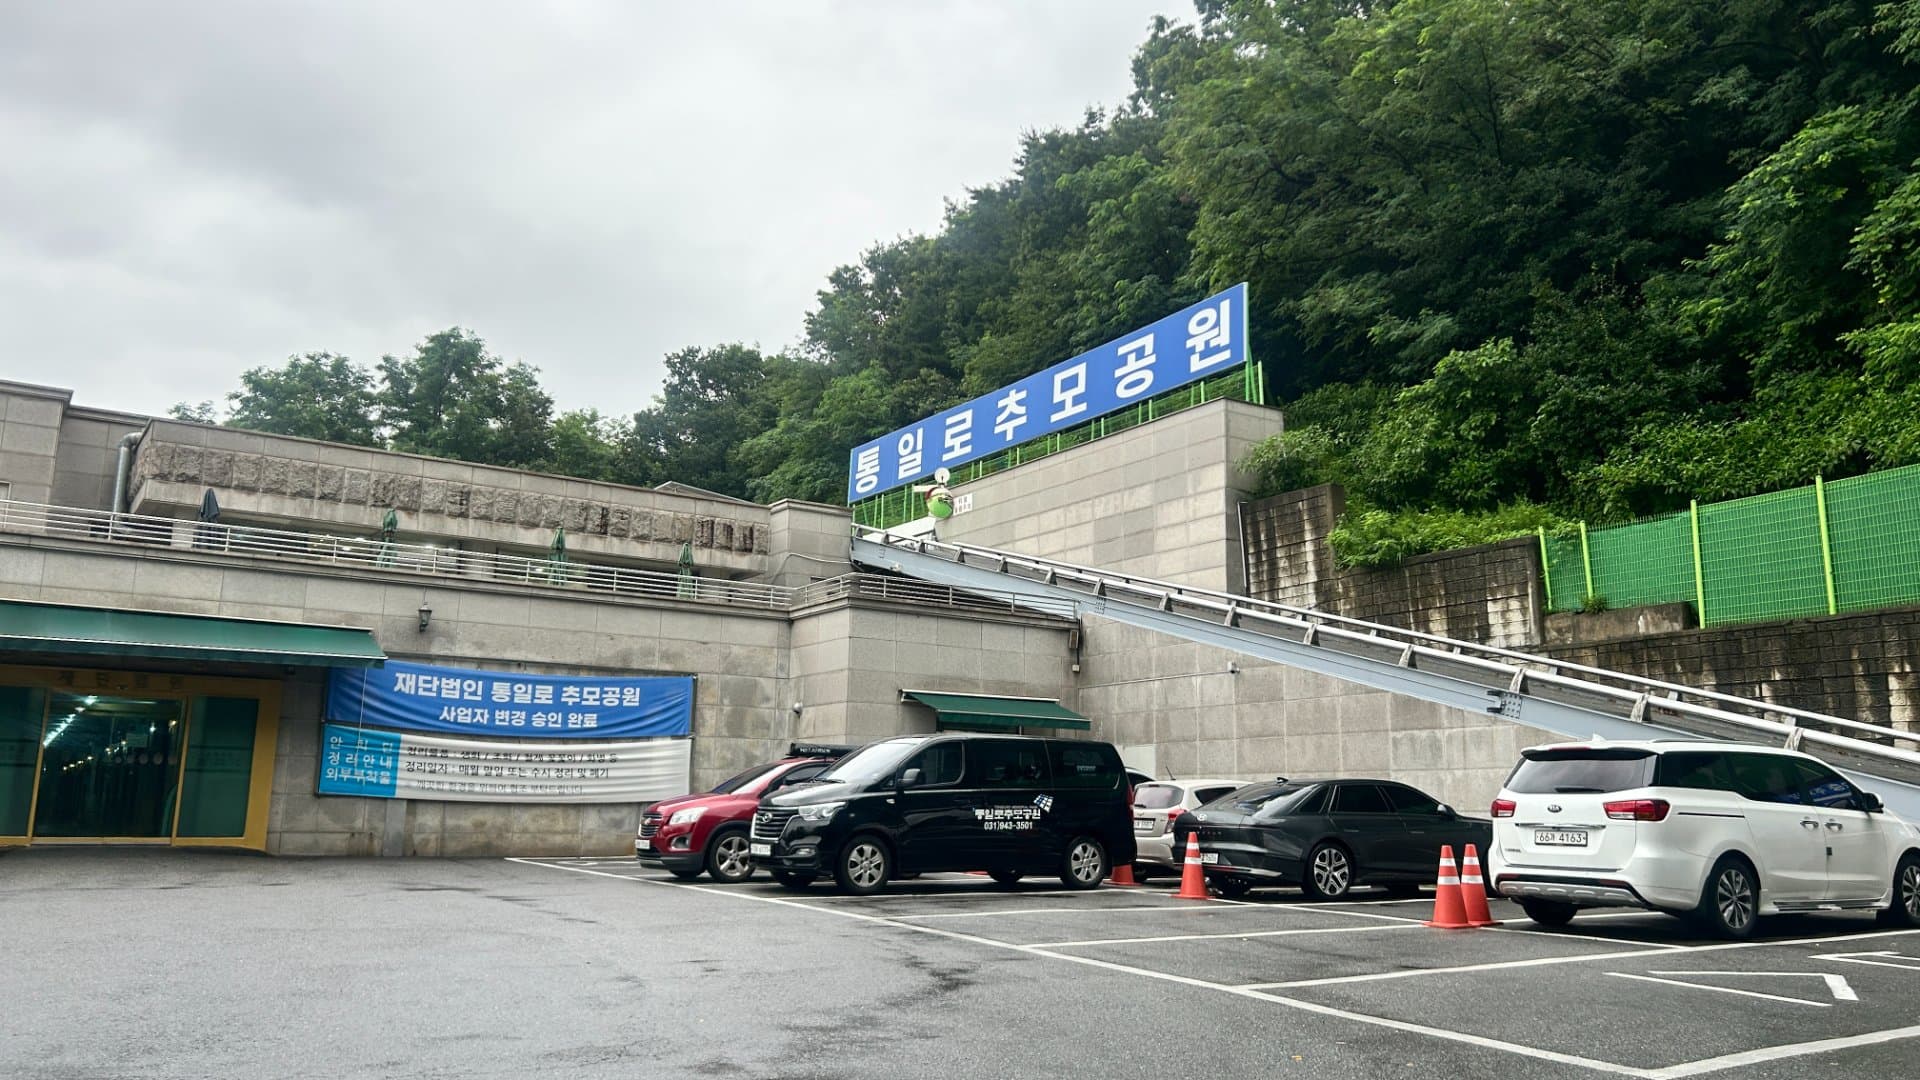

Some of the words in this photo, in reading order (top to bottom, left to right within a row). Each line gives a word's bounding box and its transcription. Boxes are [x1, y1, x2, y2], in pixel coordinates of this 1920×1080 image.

[393, 672, 483, 701] 재단법인
[491, 681, 553, 704] 통일로
[560, 685, 641, 707] 추모공원
[439, 706, 489, 724] 사업자
[495, 710, 526, 727] 변경
[531, 712, 562, 728] 승인
[567, 713, 598, 728] 완료
[406, 761, 448, 774] 정리일자
[458, 764, 479, 777] 매월
[508, 767, 527, 778] 또는
[532, 767, 550, 778] 수시
[554, 767, 573, 778] 정리
[577, 767, 586, 778] 및
[975, 808, 1041, 820] 통일로추모공원
[984, 821, 1033, 831] 031)943-3501
[1558, 832, 1582, 843] 4163
